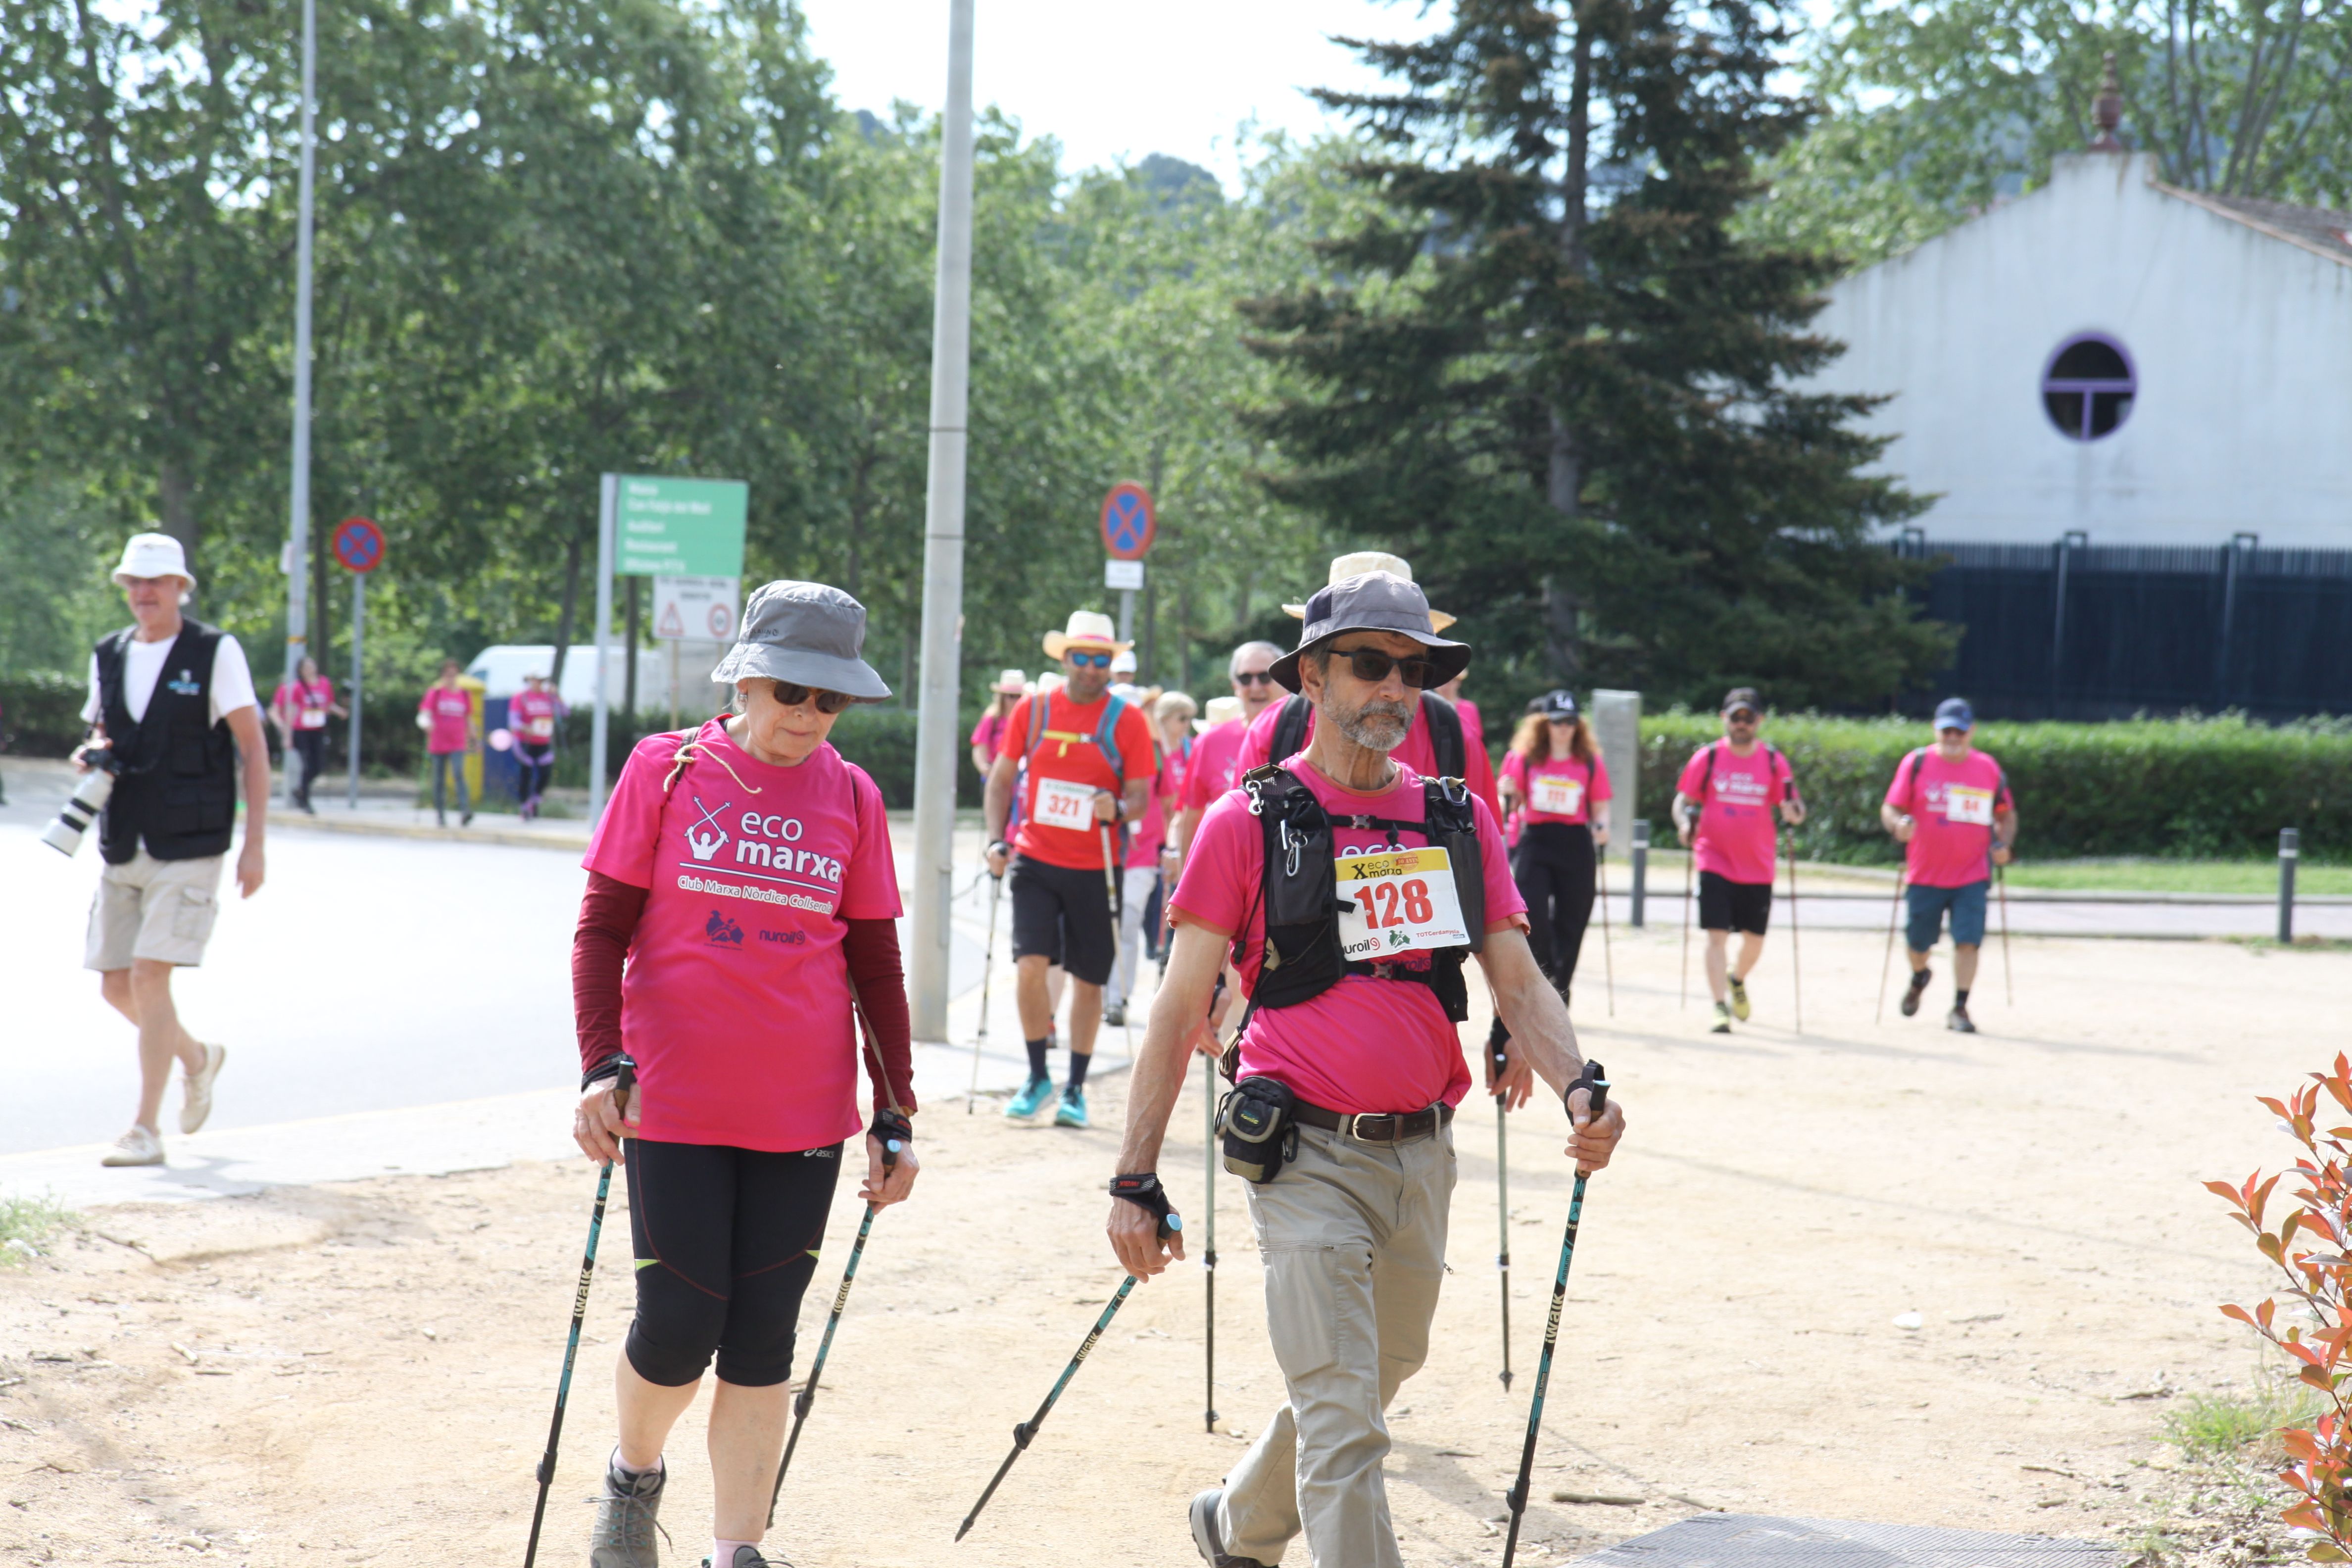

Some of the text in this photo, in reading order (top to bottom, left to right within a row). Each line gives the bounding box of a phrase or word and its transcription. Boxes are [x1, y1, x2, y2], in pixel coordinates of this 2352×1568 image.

[1049, 794, 1079, 817] 321
[740, 811, 803, 842] eco
[735, 838, 842, 883] marxa
[1351, 860, 1389, 880] X eco
[1370, 868, 1402, 878] marxa
[678, 875, 833, 915] Club Marxa Nòrdica Collserola
[1354, 879, 1433, 930] 128
[759, 930, 796, 944] nuroil
[816, 1149, 835, 1158] asics
[574, 1268, 594, 1318] iwalk
[1545, 1292, 1565, 1344] iwalk
